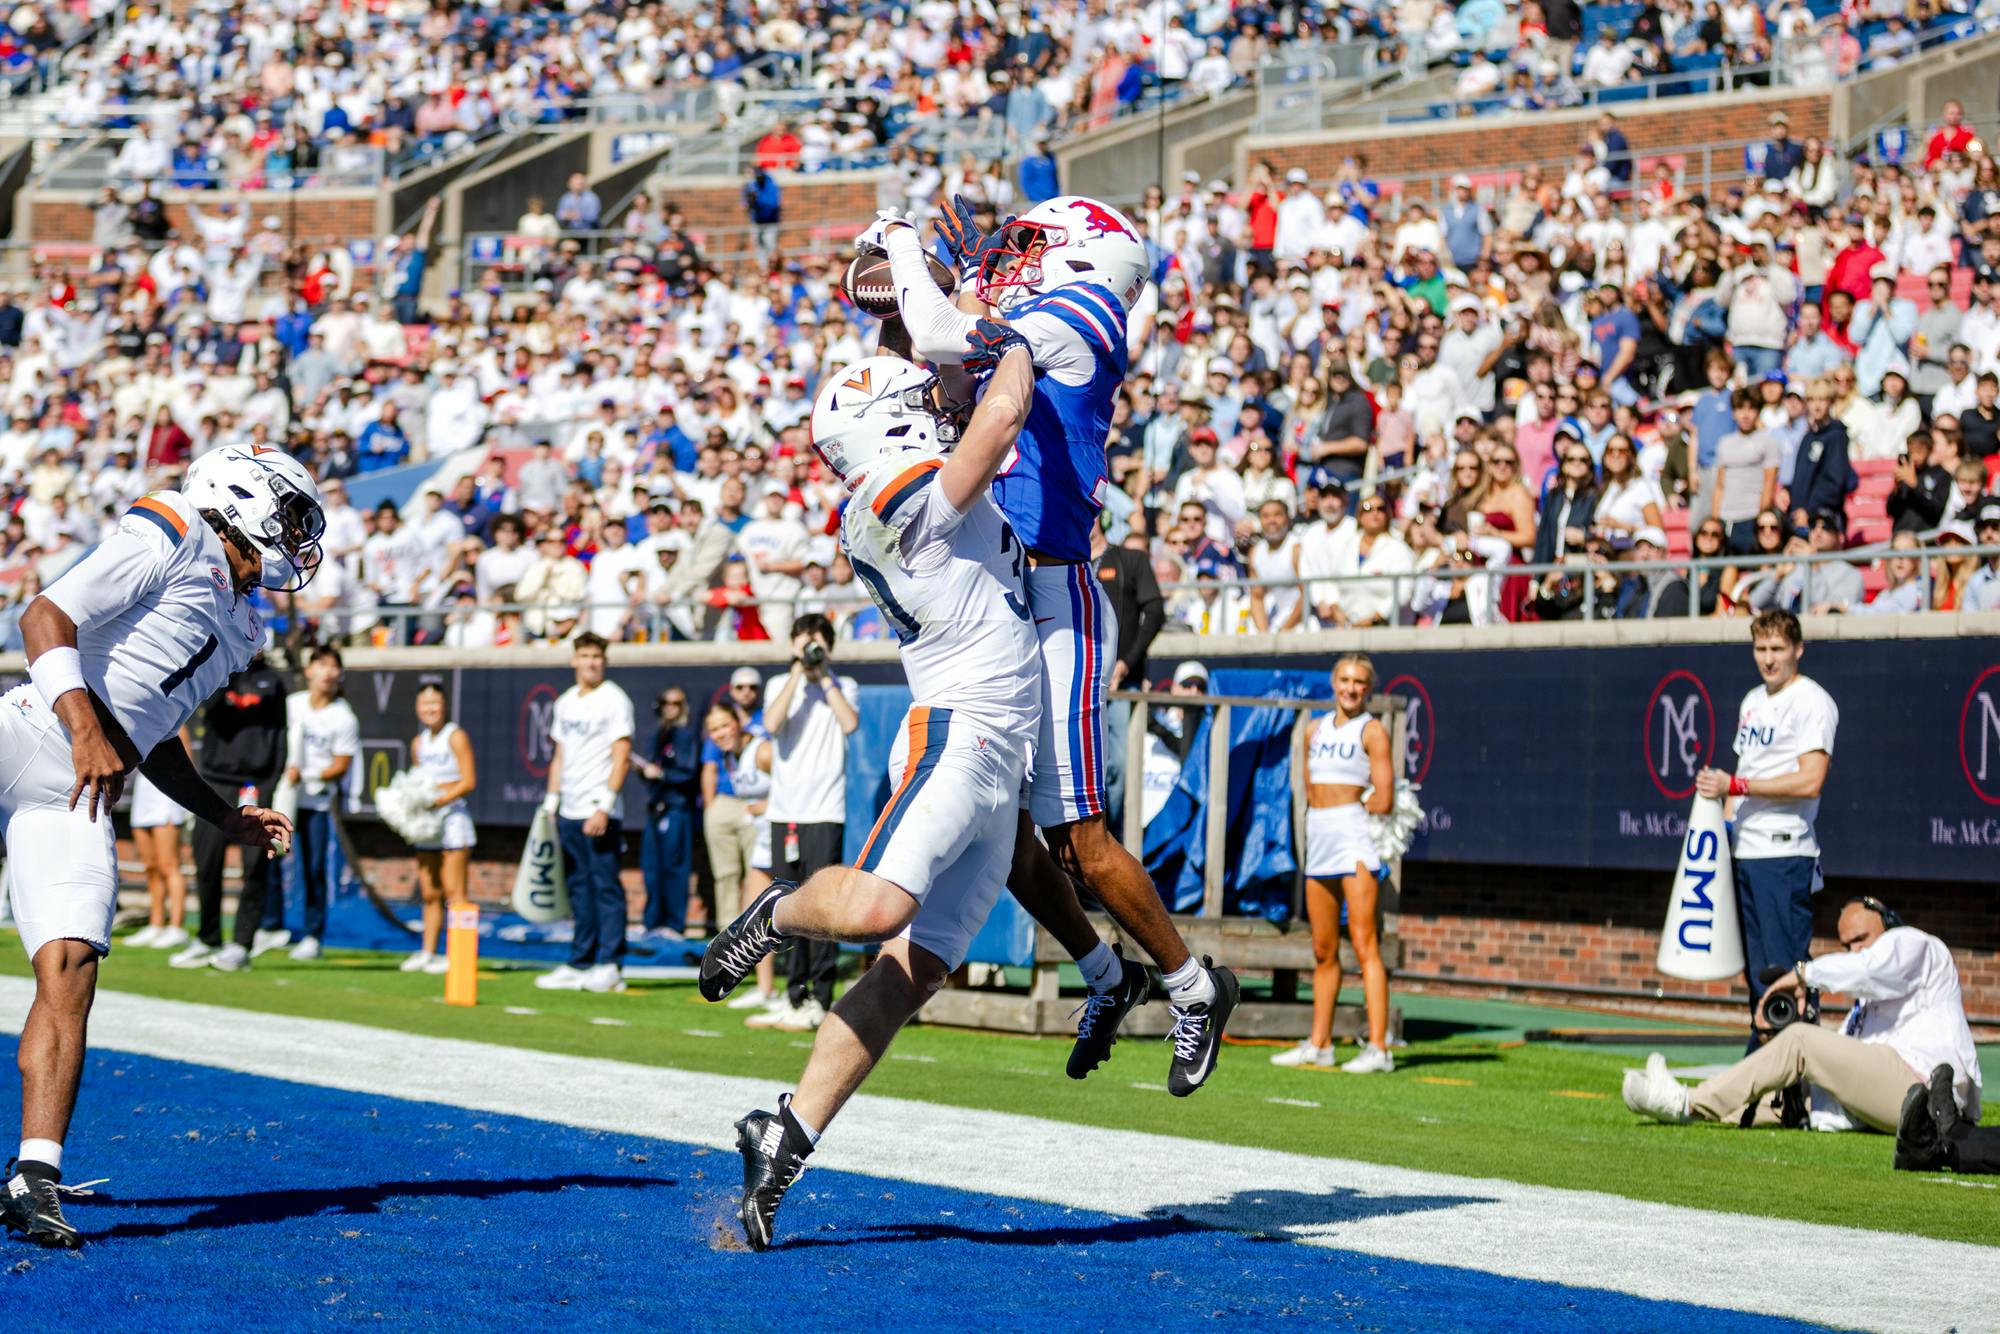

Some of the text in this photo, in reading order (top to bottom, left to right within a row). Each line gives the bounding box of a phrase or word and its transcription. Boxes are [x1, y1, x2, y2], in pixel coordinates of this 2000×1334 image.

[160, 632, 219, 698] 1
[1308, 743, 1356, 760] SMU
[1619, 809, 1641, 835] The
[1930, 817, 1956, 845] The
[531, 839, 556, 909] SMU
[1678, 828, 1718, 954] SMU
[759, 1120, 785, 1159] NIKE
[8, 1173, 31, 1199] NIKE
